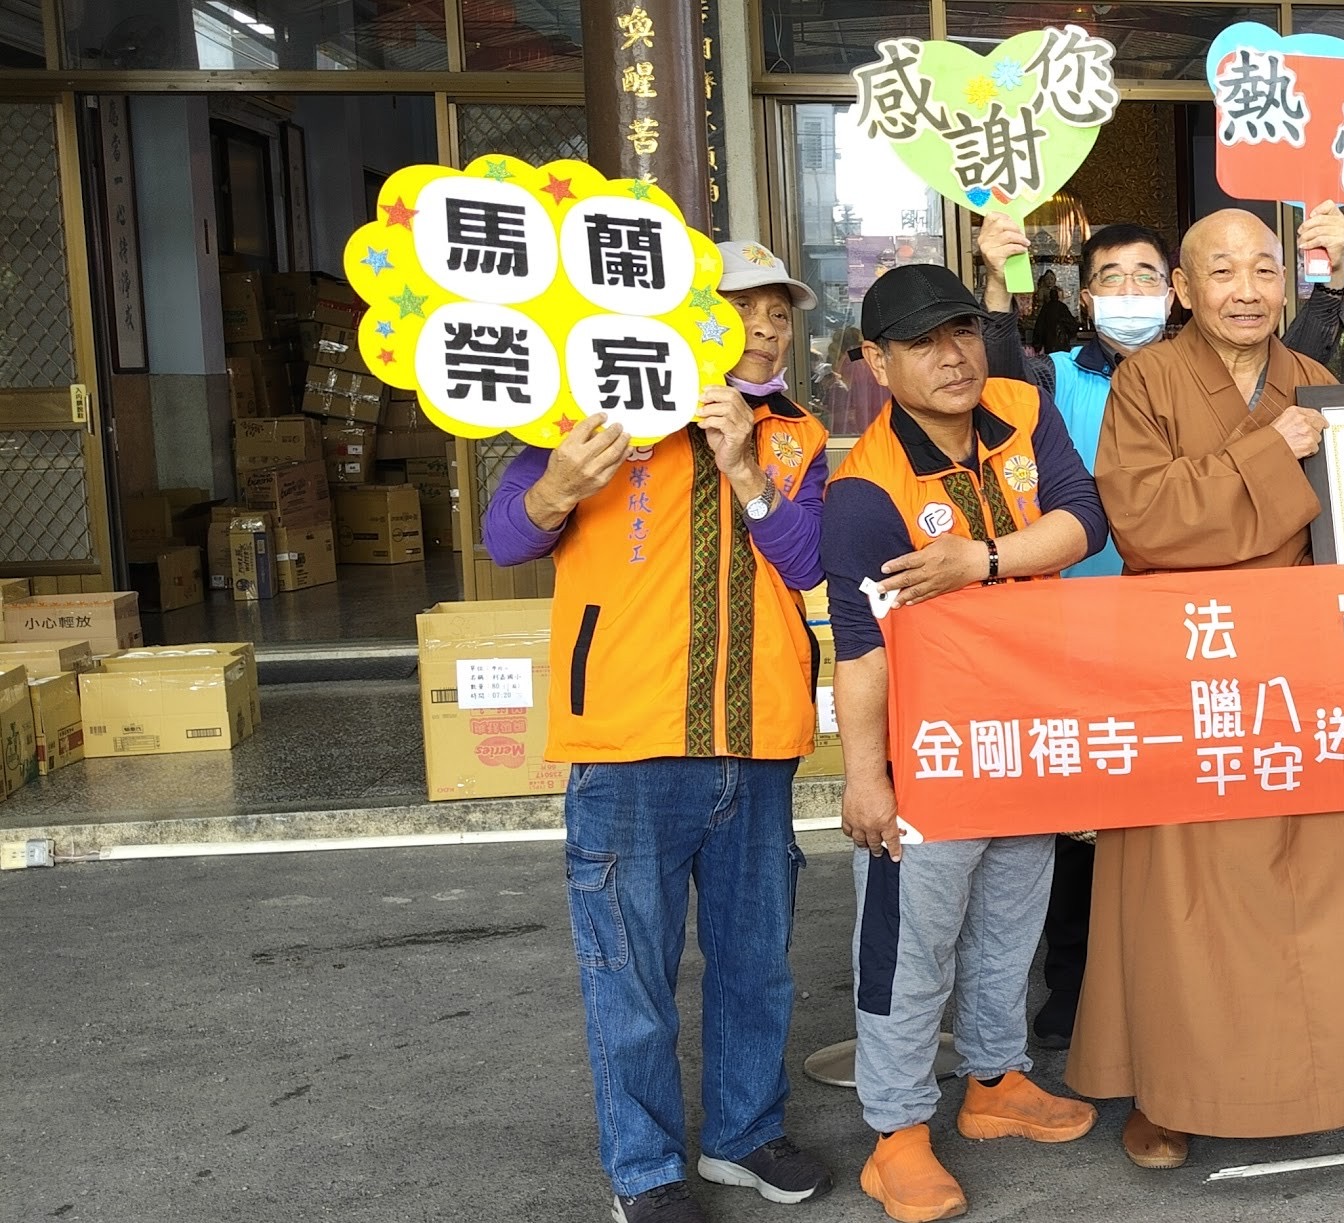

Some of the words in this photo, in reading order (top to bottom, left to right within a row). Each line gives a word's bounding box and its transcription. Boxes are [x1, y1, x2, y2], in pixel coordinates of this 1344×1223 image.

[617, 6, 660, 184] 喚醒苦
[628, 466, 652, 564] 榮欣志工
[25, 615, 92, 631] 小心輕放
[1191, 676, 1302, 740] 臘八
[476, 743, 526, 757] Merries
[1196, 742, 1304, 796] 平安
